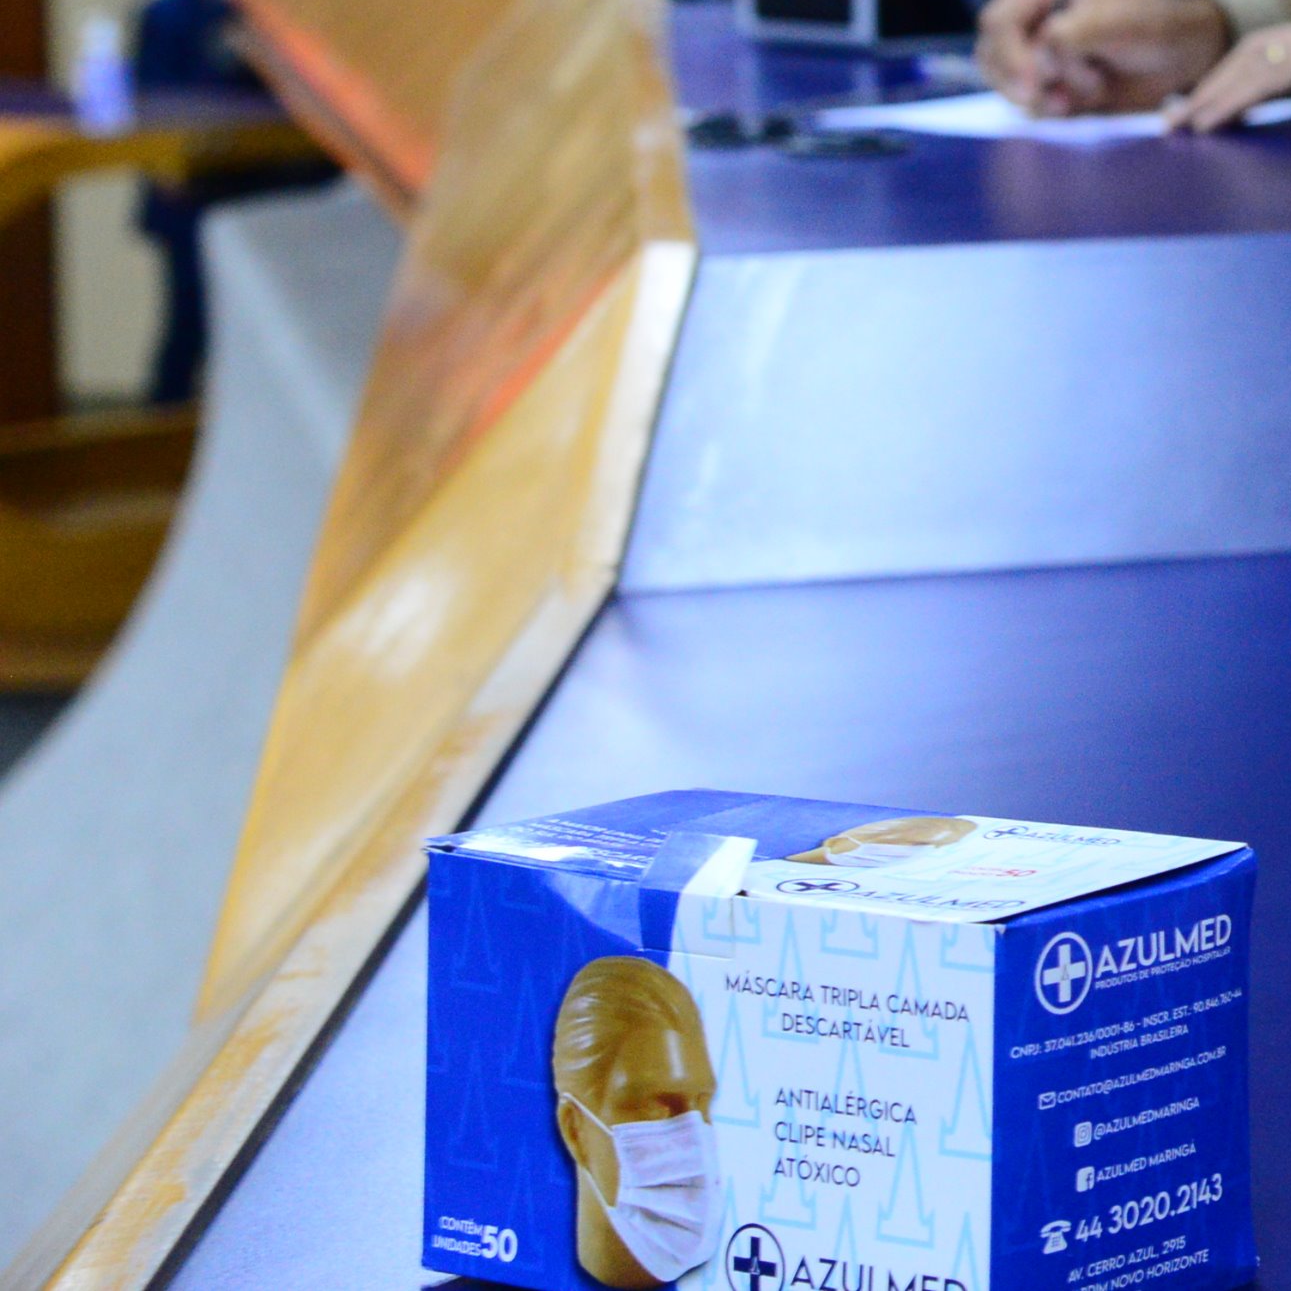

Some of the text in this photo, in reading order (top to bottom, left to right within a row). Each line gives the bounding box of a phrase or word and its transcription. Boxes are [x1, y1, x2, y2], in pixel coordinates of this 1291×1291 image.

[849, 890, 1026, 909] AZULMED
[1095, 914, 1232, 979] AZULMED
[724, 970, 970, 1023] MÁSCARA TRIPLA CAMADA
[1095, 973, 1138, 989] PRODUTOS
[1139, 969, 1150, 980] DE
[781, 1012, 911, 1049] DESCARTÁVEL
[1140, 1024, 1189, 1047] BRASILEIRA
[1010, 1045, 1042, 1059] CNPJ:
[774, 1087, 918, 1125] ANTIALÉRGICA
[1094, 1097, 1200, 1140] @AZULMEDMARINGA
[774, 1121, 896, 1158] CLIPE NASAL
[773, 1154, 861, 1188] ATÓXICO
[1096, 1140, 1197, 1182] AZULMED MARINGÁ
[1075, 1173, 1223, 1242] 44 3020.2143
[481, 1225, 518, 1263] 50
[1067, 1235, 1186, 1284] AV. CERRO AZUL, 2915
[1111, 1268, 1145, 1291] NOVO
[1146, 1248, 1210, 1278] HORIZONTE
